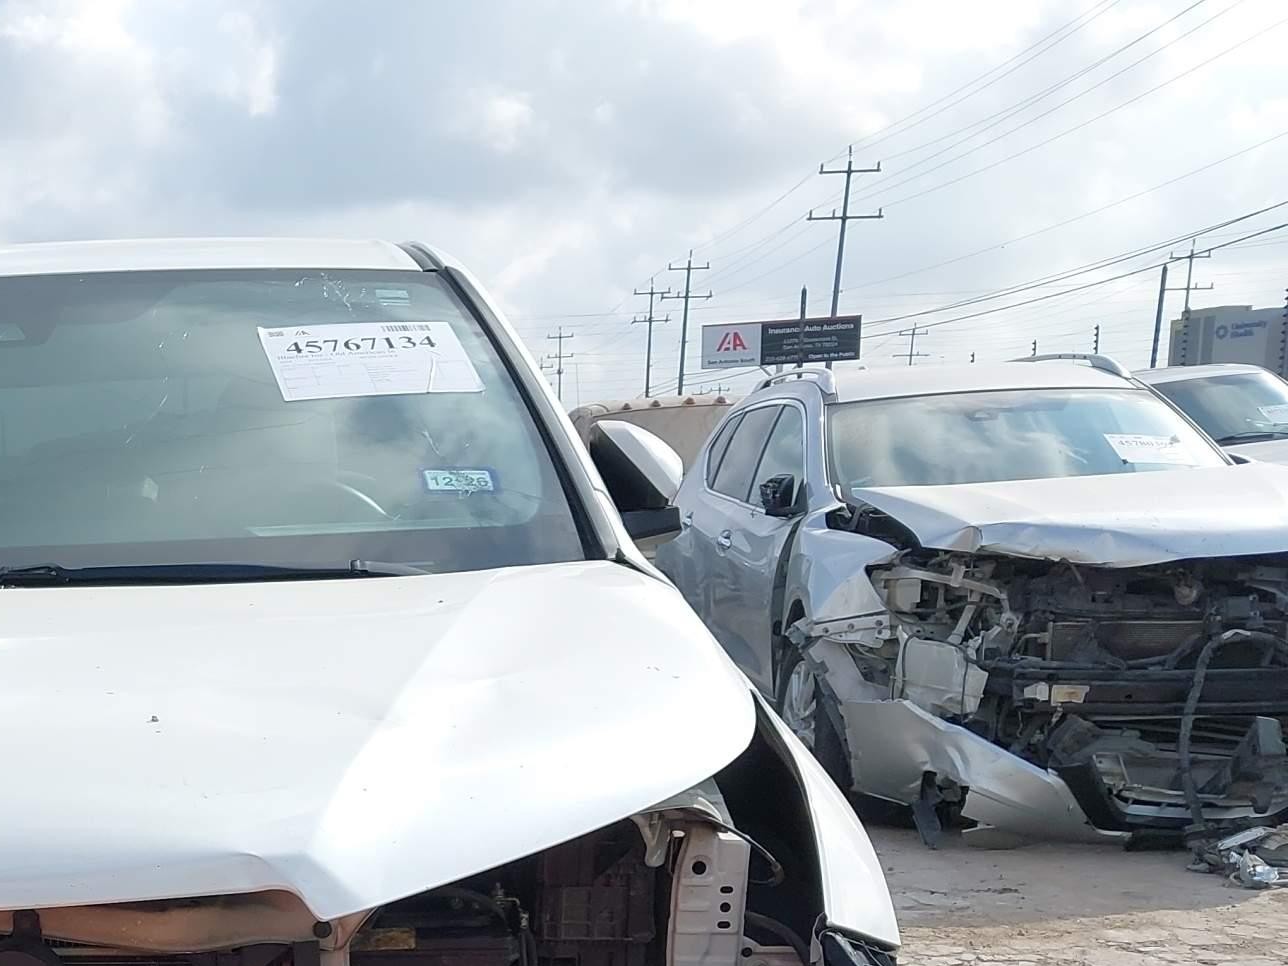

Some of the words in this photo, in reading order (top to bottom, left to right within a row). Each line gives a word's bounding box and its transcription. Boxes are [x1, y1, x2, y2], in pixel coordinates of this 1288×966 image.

[768, 327, 800, 335] Insuranc
[805, 325, 822, 333] Auto
[823, 323, 854, 332] Auctions
[286, 335, 437, 354] 45767134
